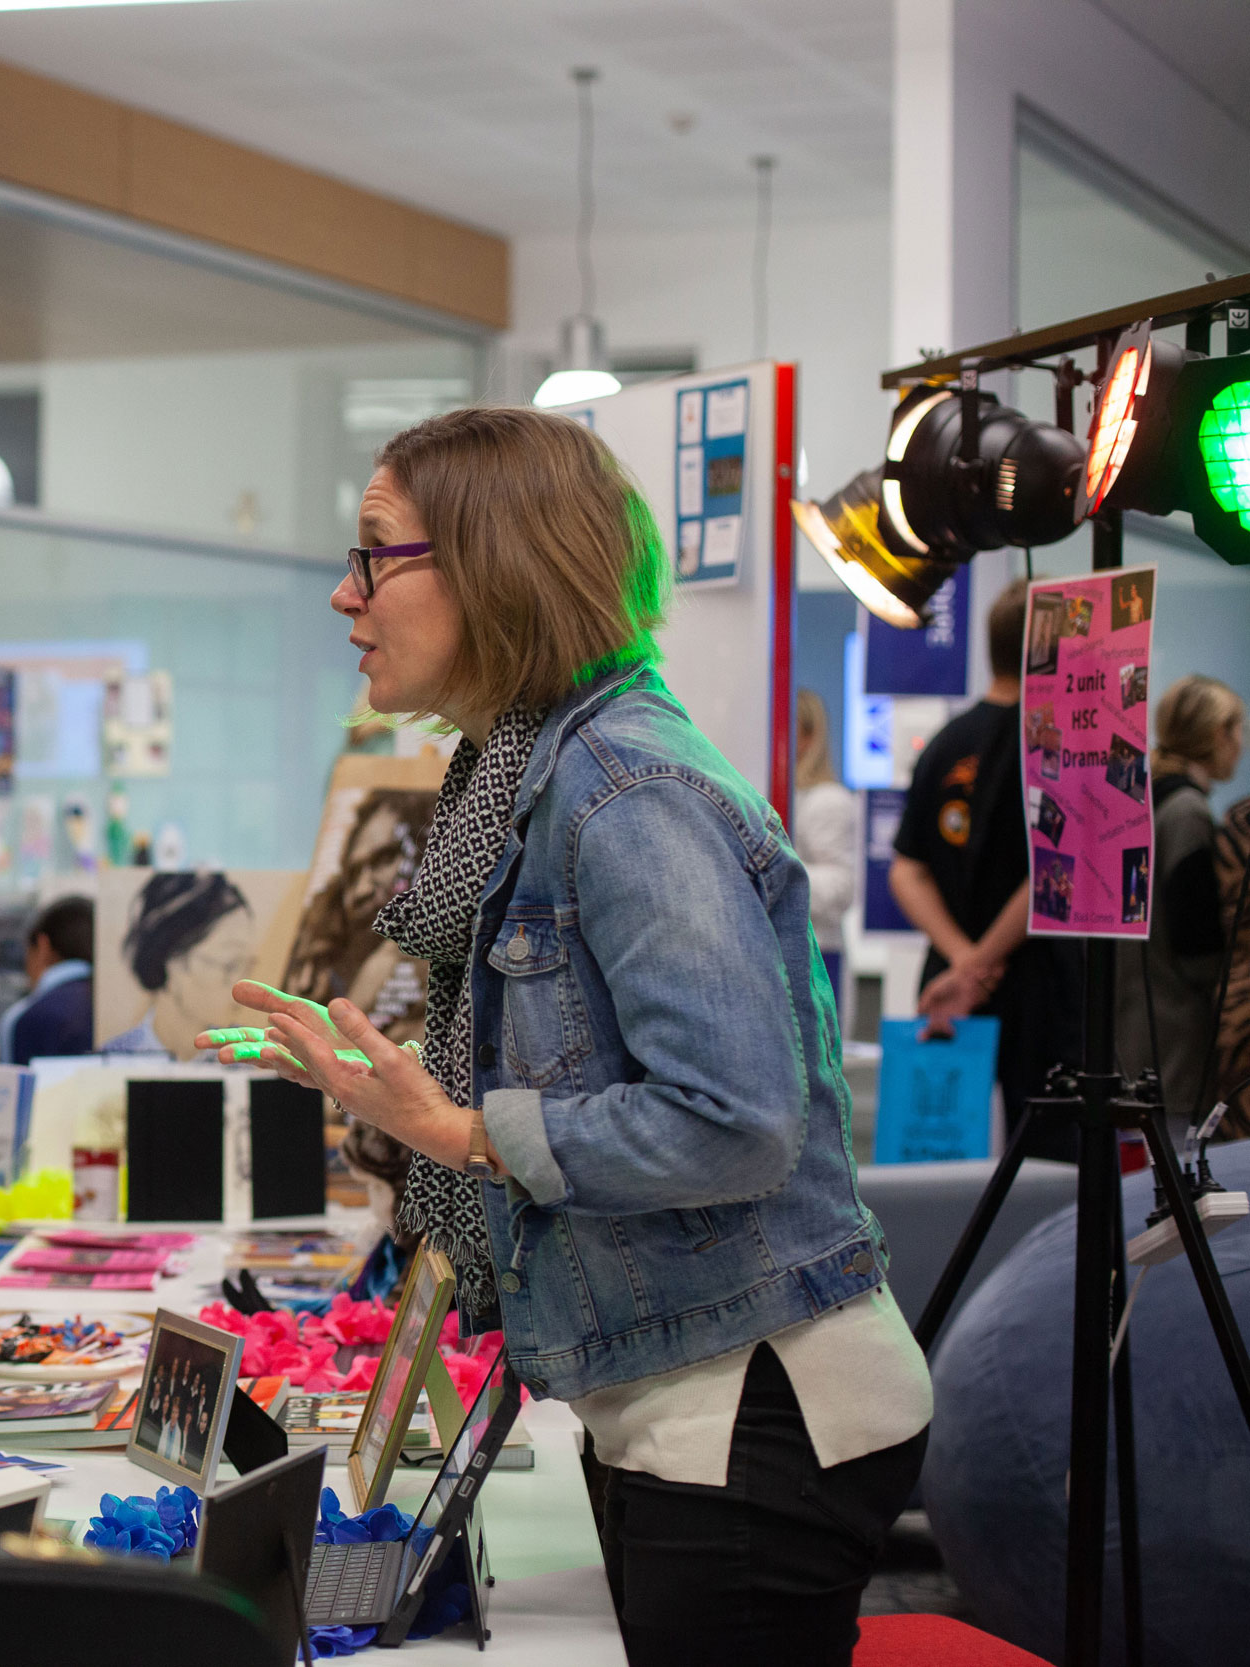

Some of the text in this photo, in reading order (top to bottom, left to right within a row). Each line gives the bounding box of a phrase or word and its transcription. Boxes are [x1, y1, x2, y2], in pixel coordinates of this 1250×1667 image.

[1065, 672, 1075, 694] 2
[1077, 669, 1107, 693] unit
[1071, 708, 1099, 730] HSC
[1062, 748, 1108, 769] Drama
